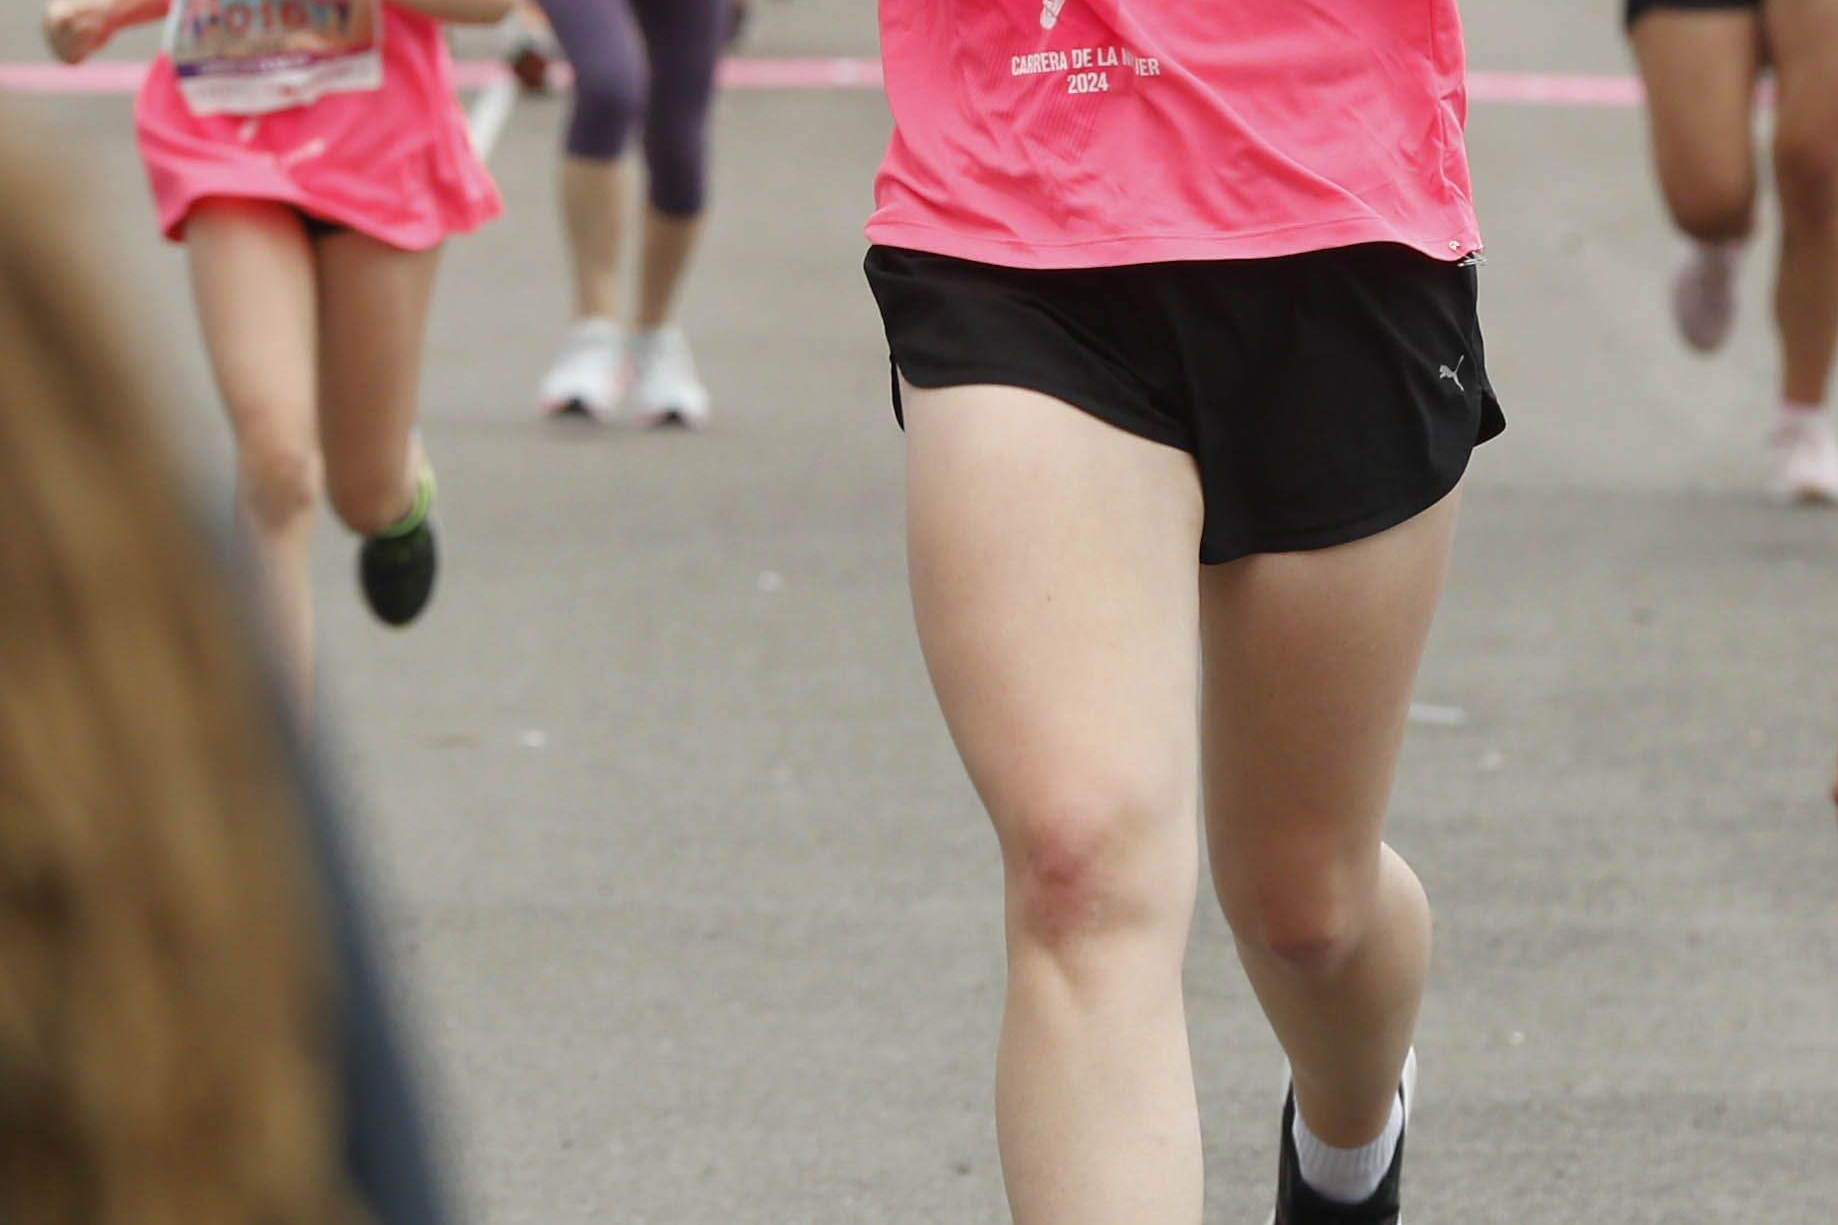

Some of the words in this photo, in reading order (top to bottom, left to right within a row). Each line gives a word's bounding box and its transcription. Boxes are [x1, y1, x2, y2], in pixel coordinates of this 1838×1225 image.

[1011, 51, 1068, 76] CARRERA
[1071, 48, 1093, 69] DE
[1097, 46, 1119, 67] LA
[1066, 72, 1109, 94] 2024
